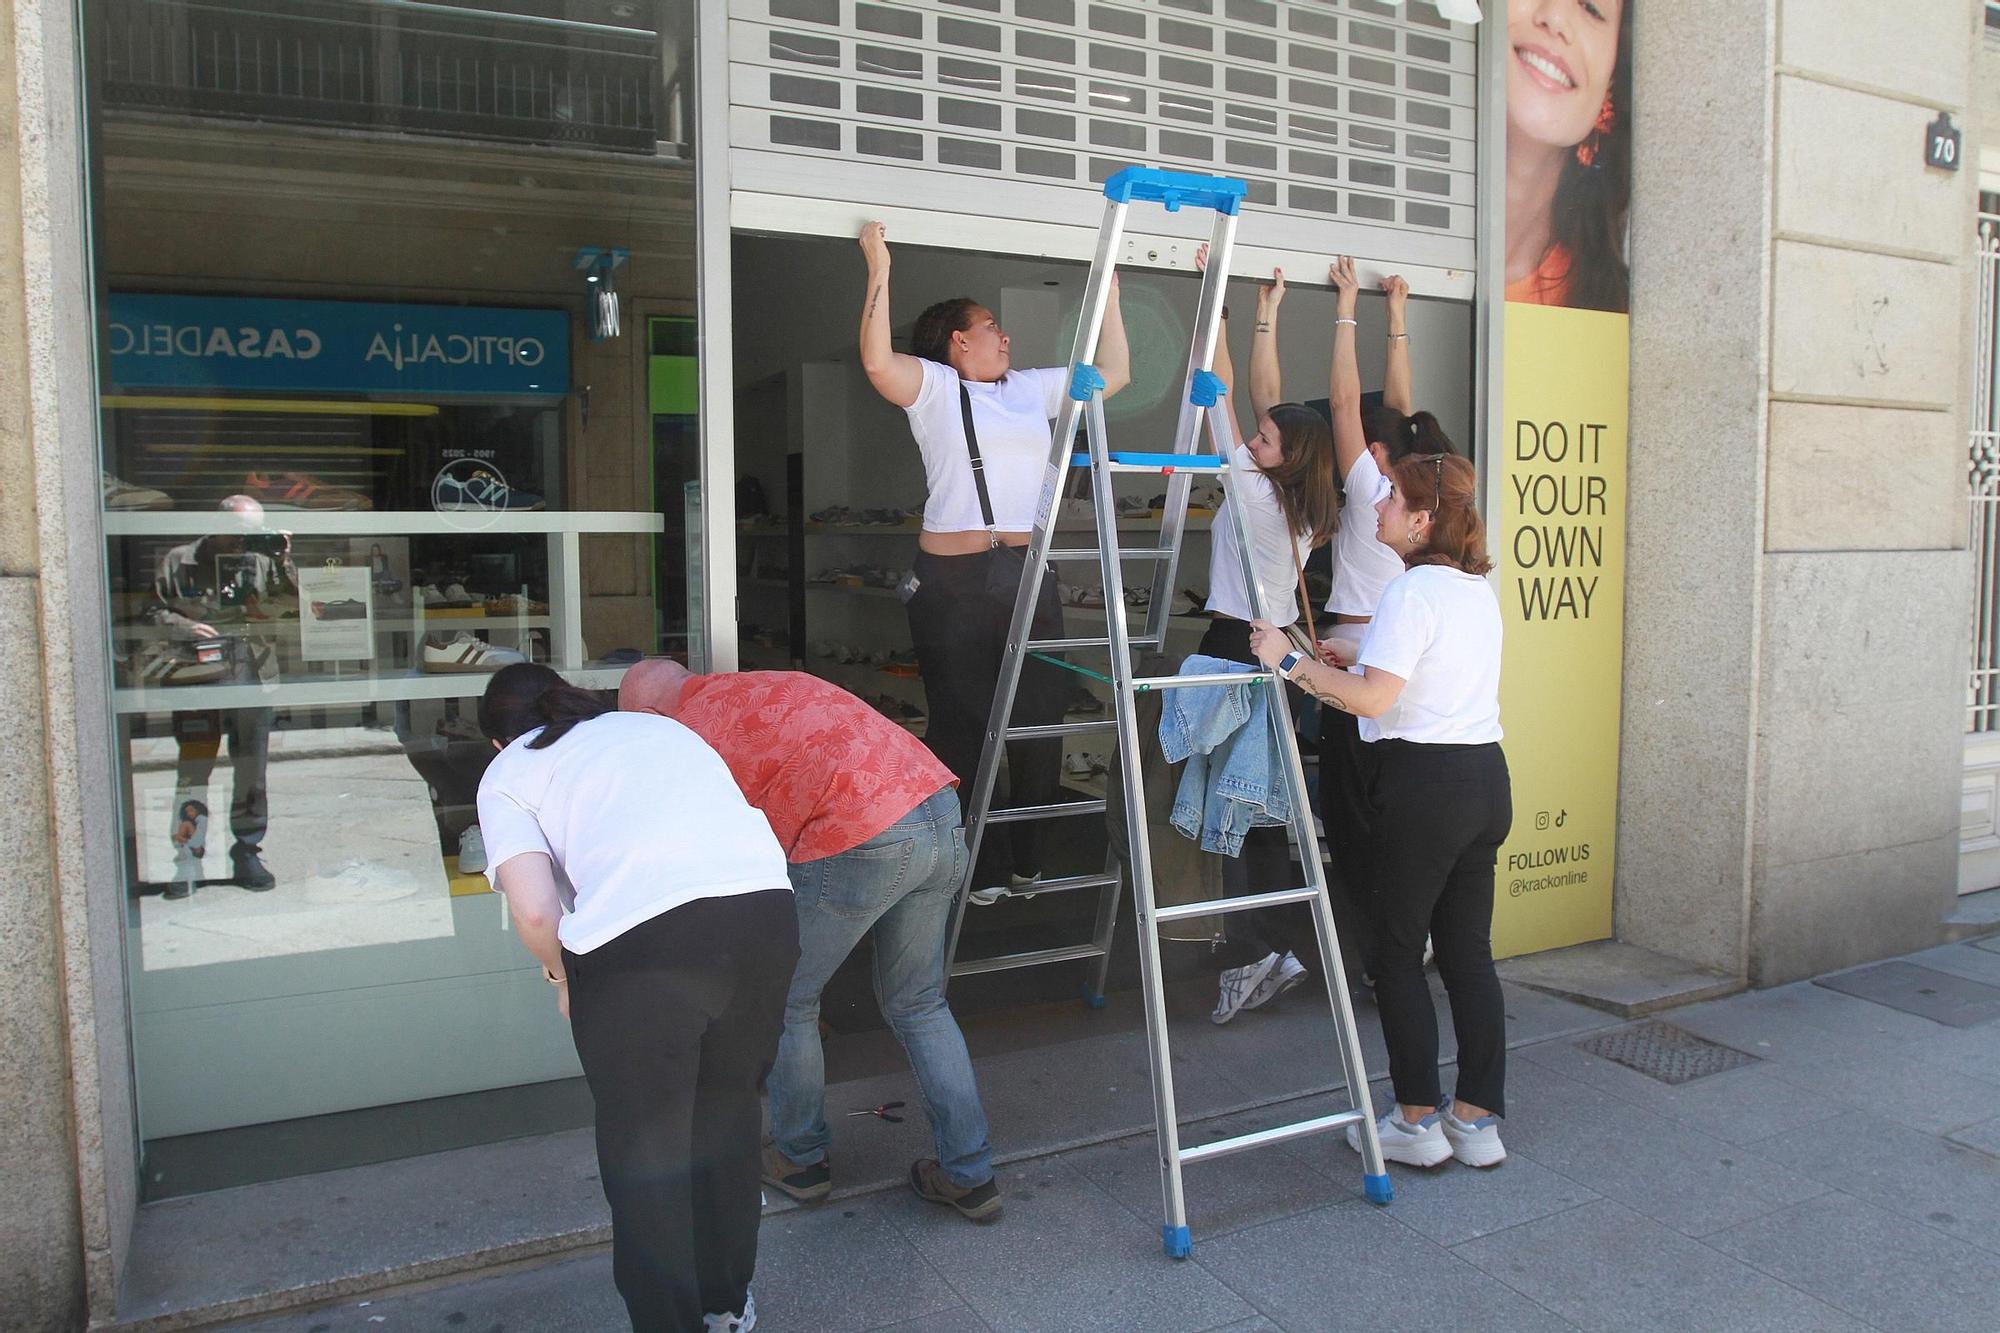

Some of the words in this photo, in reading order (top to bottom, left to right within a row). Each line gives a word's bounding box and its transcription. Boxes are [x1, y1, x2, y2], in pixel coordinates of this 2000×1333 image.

[1933, 136, 1955, 163] 70
[1516, 420, 1569, 463] DO
[1579, 423, 1608, 463] IT
[1512, 474, 1607, 516] YOUR
[1513, 525, 1602, 569] OWN
[1518, 576, 1599, 621] WAY
[1508, 847, 1569, 872] FOLLOW
[1571, 844, 1590, 862] US
[1509, 870, 1588, 898] @krackonline
